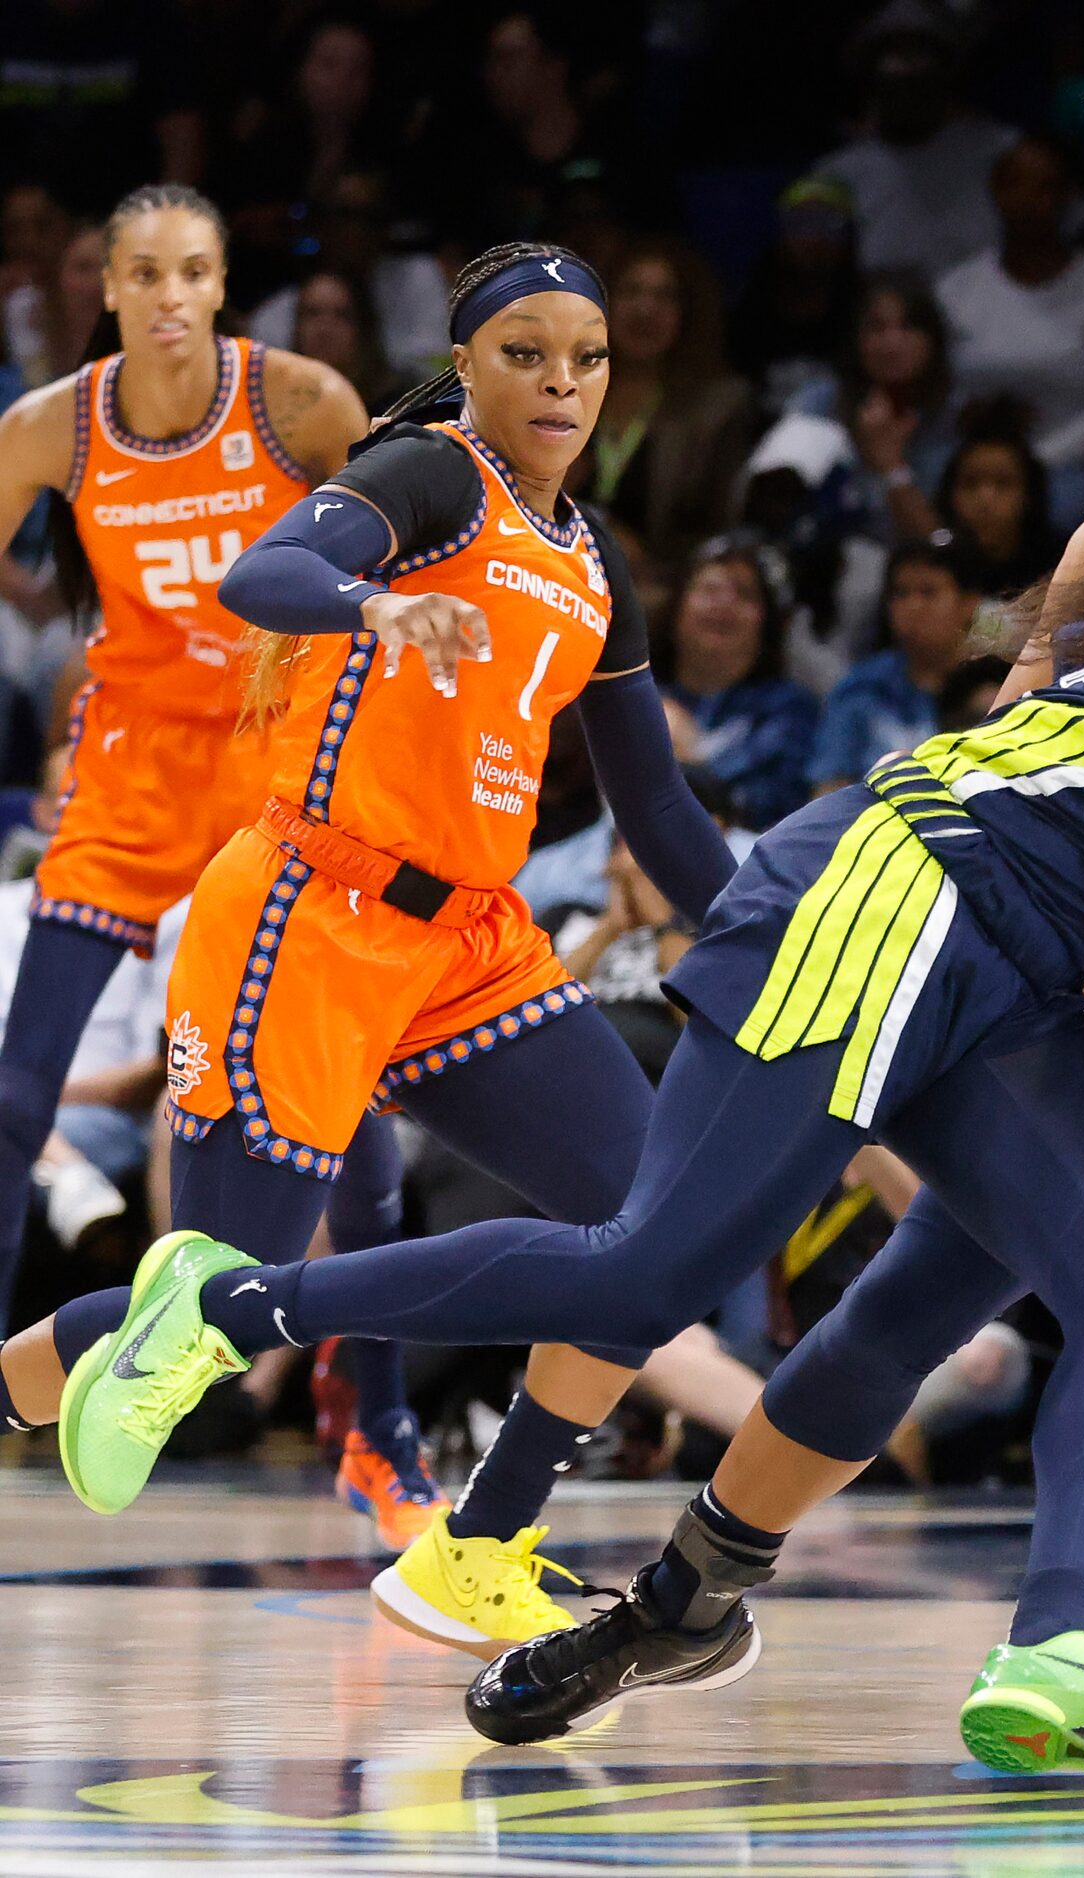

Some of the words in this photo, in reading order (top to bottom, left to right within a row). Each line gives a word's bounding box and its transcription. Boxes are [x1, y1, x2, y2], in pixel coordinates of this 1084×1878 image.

[93, 484, 266, 527] CONNECTICUT
[134, 530, 243, 609] 24
[485, 559, 608, 641] CONNECTICU
[518, 631, 560, 721] 1
[480, 732, 513, 761] Yale
[473, 757, 539, 796] NewHav
[471, 782, 524, 816] Health
